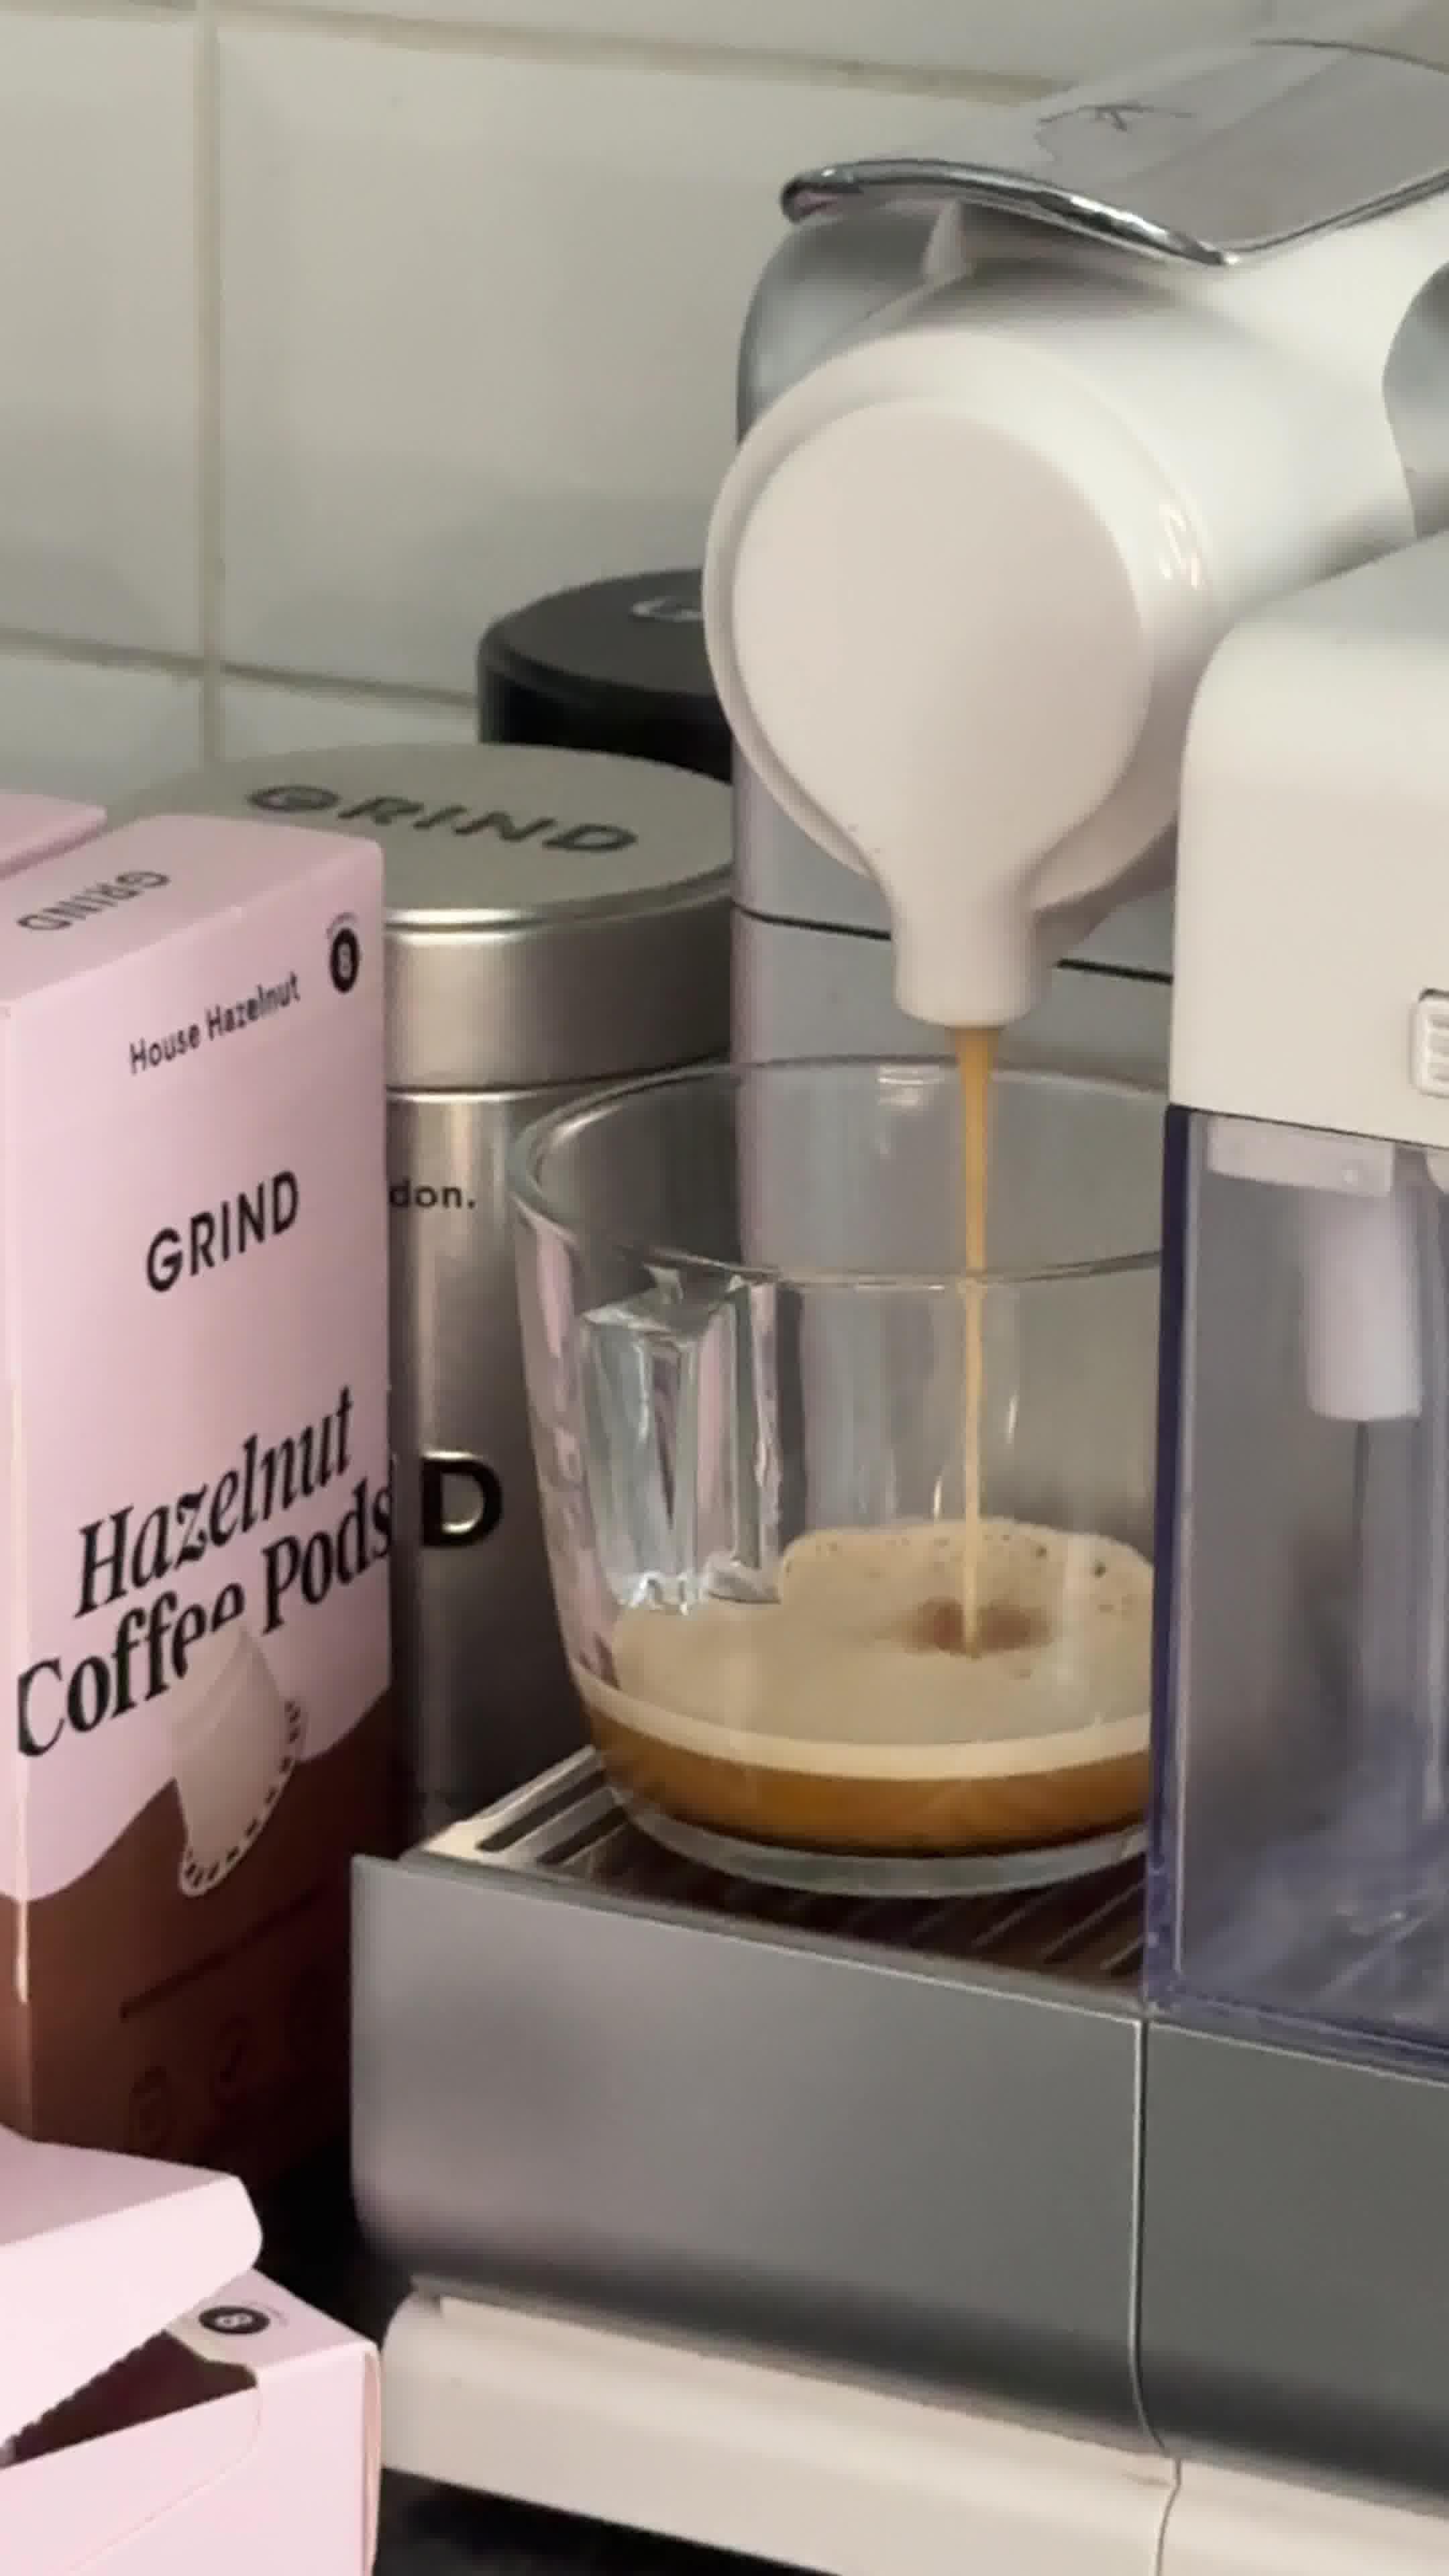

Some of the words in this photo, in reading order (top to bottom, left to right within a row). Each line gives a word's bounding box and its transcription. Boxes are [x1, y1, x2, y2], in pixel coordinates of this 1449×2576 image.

[247, 785, 637, 852] GRIND
[16, 870, 170, 932] GRIND
[129, 1022, 201, 1075] House
[205, 972, 301, 1042] Hazelnut
[146, 1170, 299, 1293] GRIND
[74, 1385, 354, 1619] Hazelnut
[261, 1476, 393, 1637] Pods
